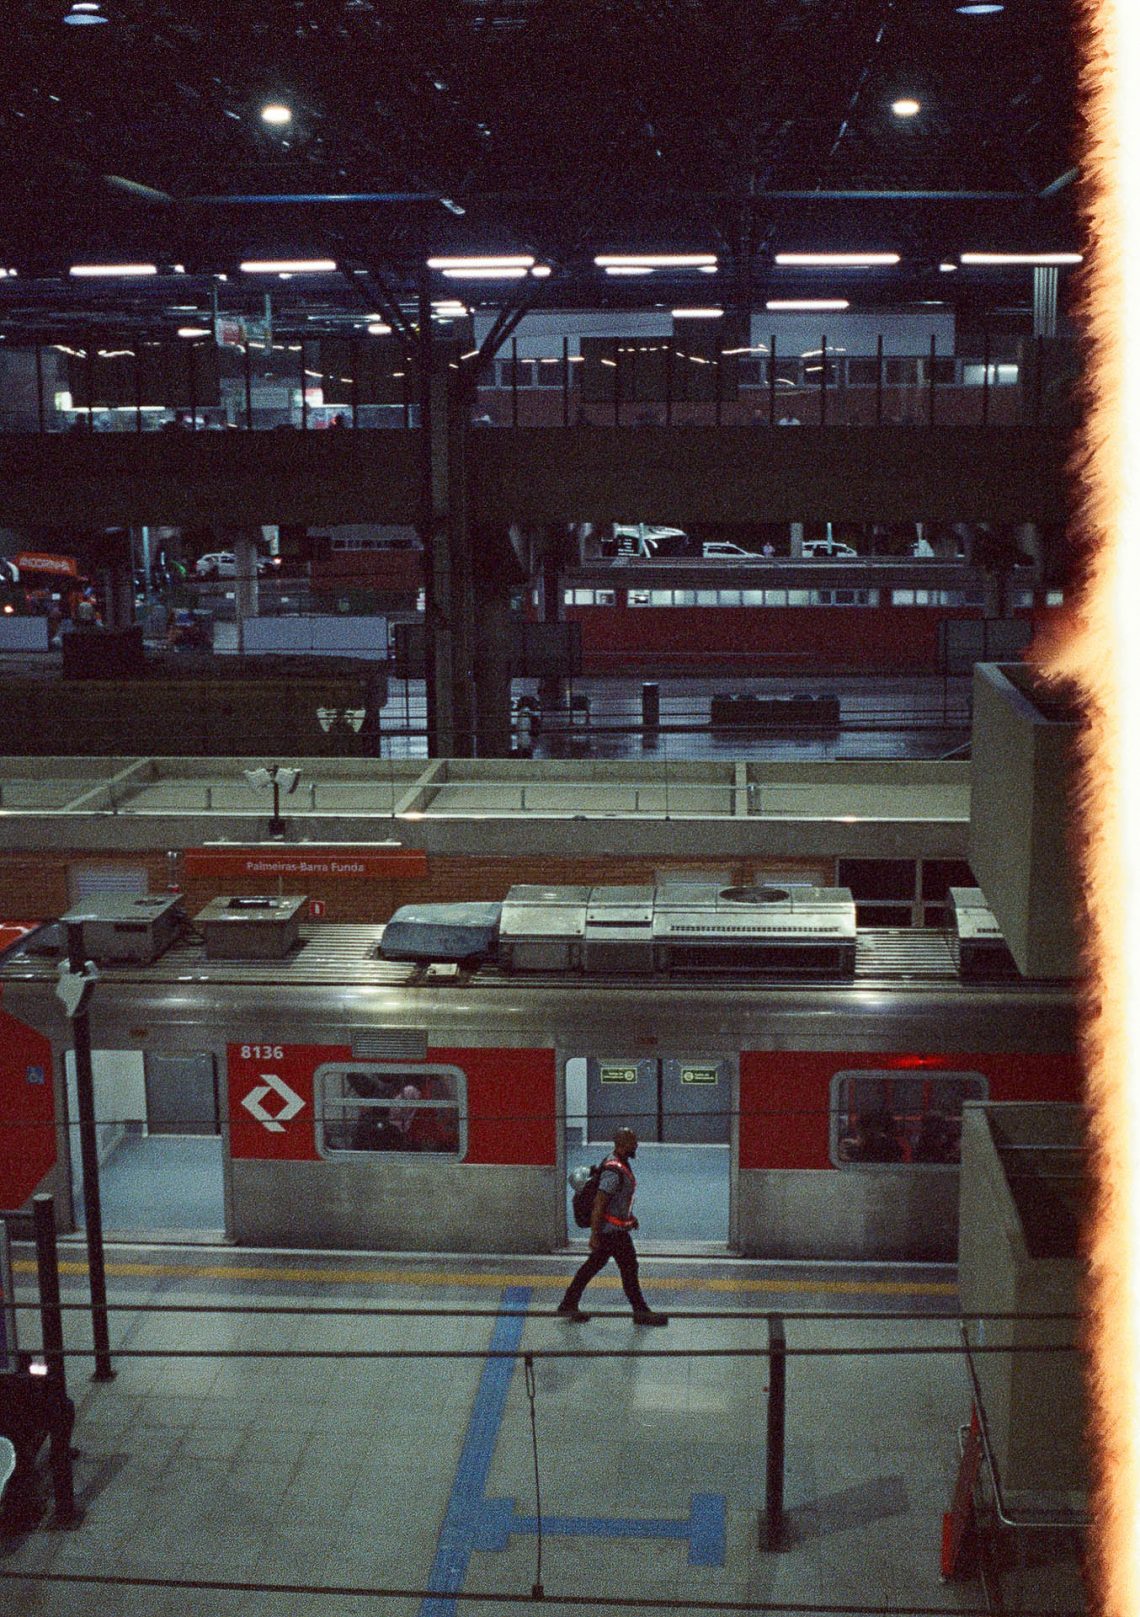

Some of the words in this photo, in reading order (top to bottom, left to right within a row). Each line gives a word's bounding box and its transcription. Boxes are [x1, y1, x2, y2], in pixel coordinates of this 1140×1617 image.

[246, 861, 328, 872] Palmeiras-Barra
[331, 862, 365, 872] Funda
[241, 1045, 283, 1059] 8136
